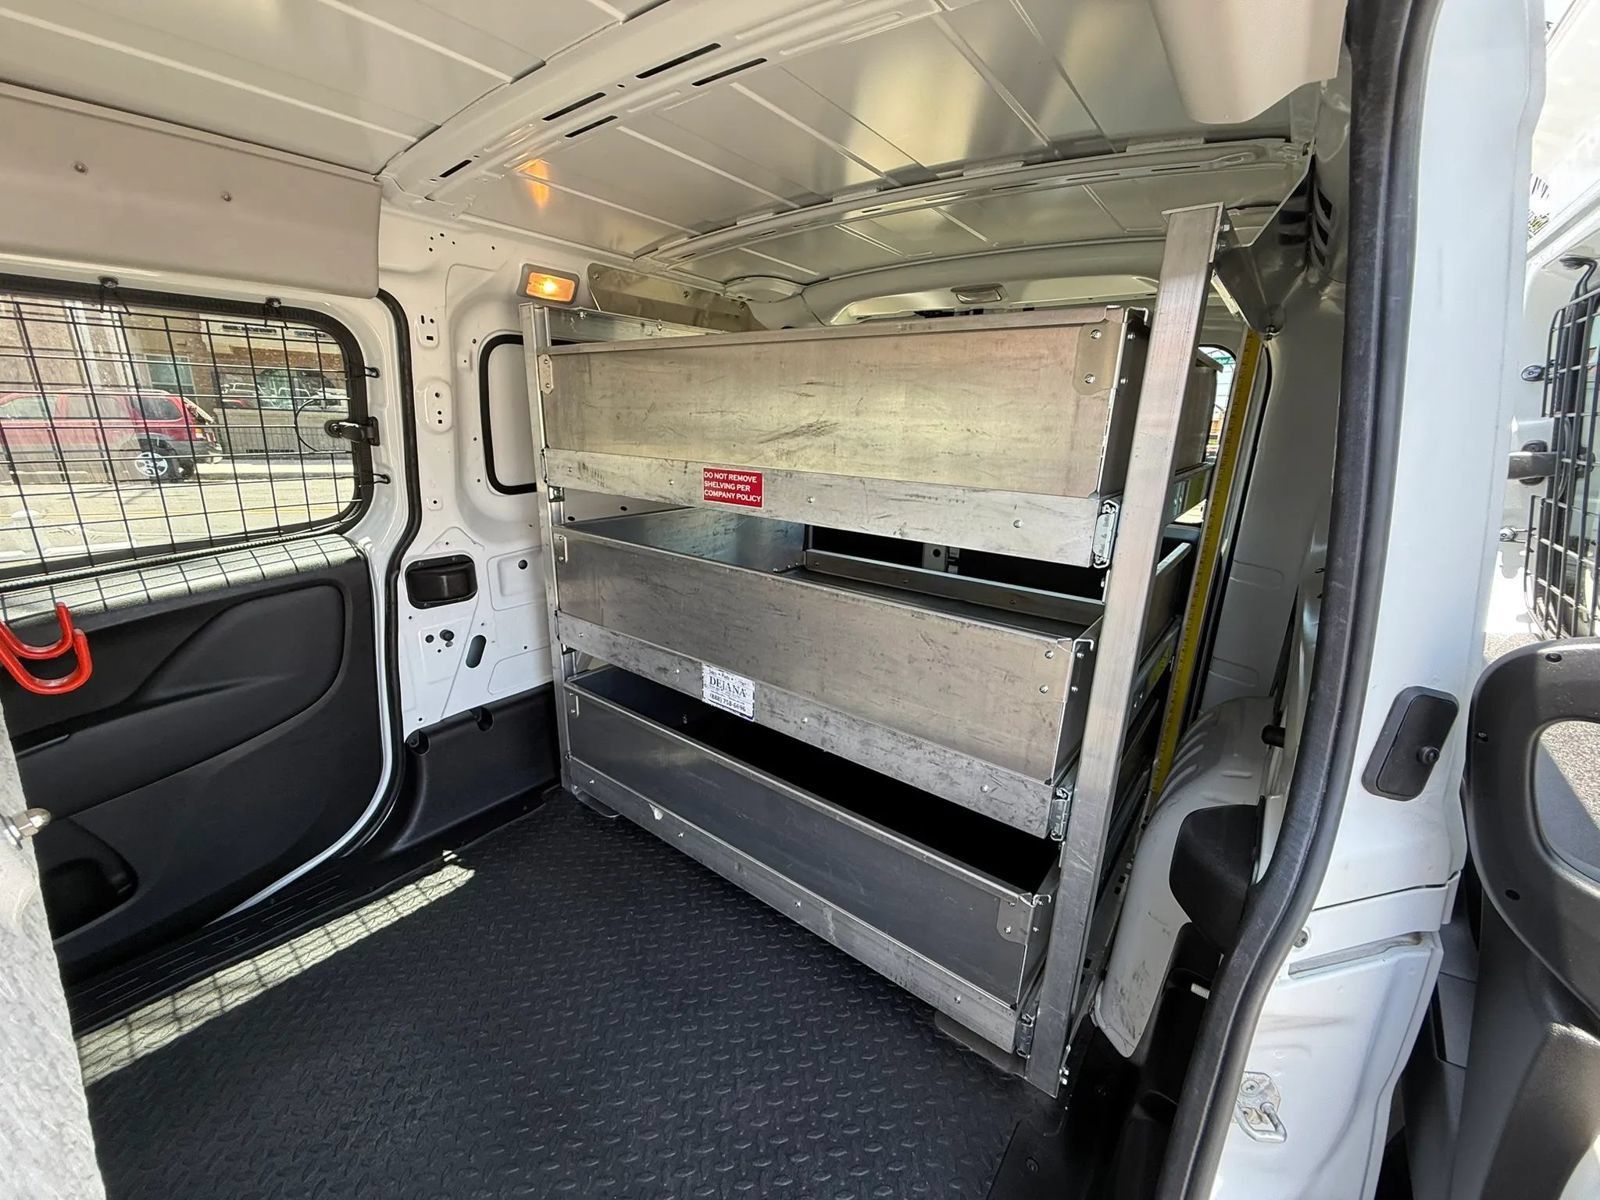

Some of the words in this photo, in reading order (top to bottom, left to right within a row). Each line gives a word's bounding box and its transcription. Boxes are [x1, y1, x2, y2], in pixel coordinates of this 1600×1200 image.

[728, 474, 757, 483] REMOVE
[704, 481, 735, 490] SHELVING
[736, 484, 751, 492] PER
[704, 490, 736, 499] COMPANY
[736, 494, 761, 502] POLICY
[710, 676, 746, 698] DEJANA
